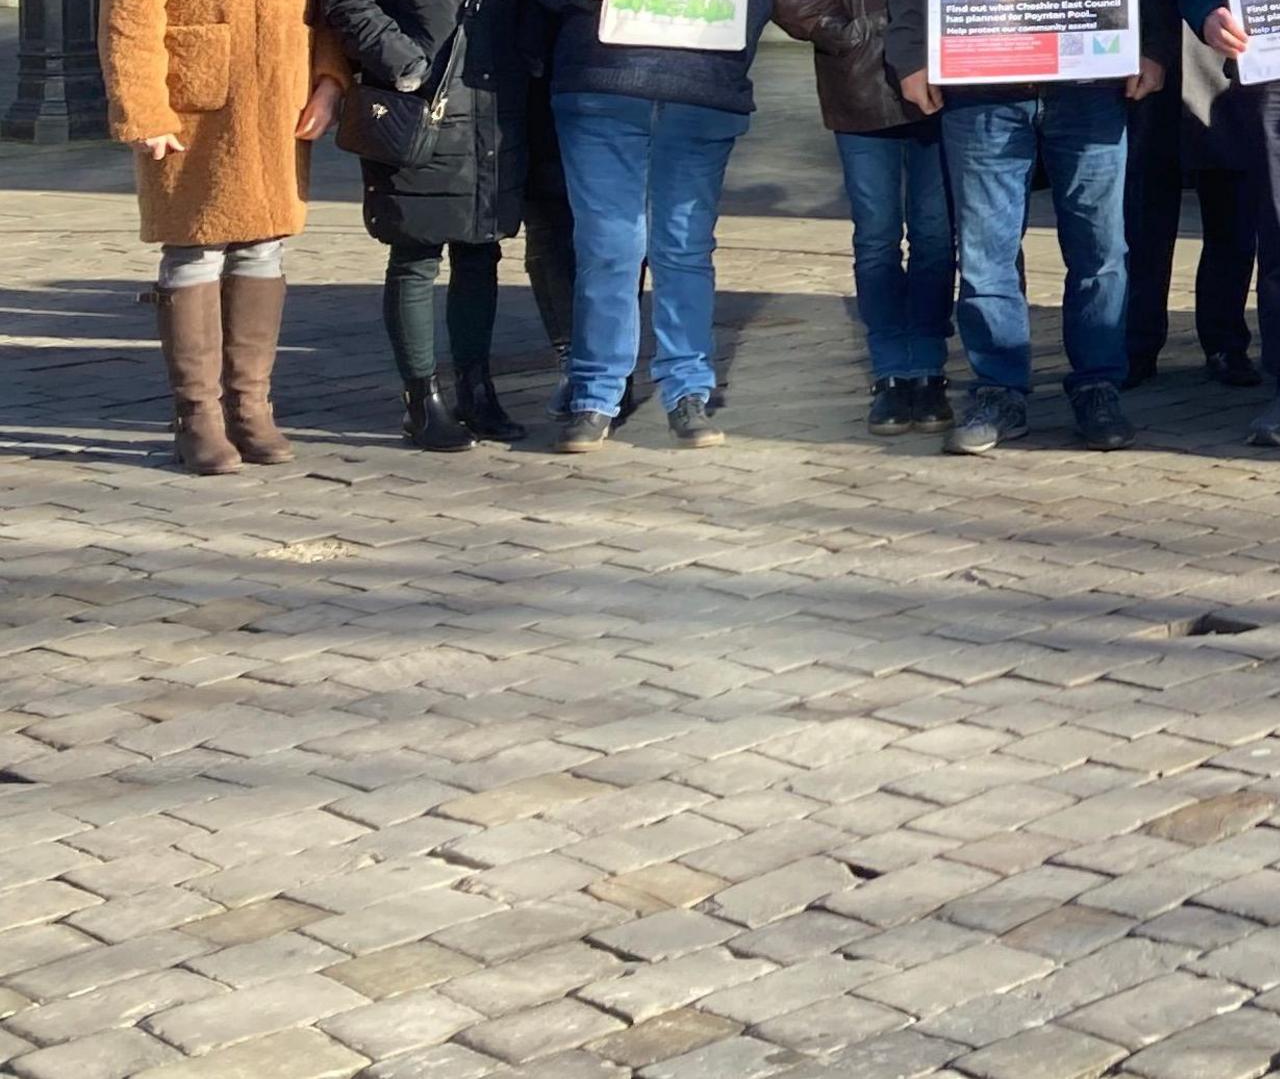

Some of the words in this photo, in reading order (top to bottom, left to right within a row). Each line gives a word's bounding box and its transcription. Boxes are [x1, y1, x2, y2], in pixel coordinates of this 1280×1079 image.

[946, 5, 968, 14] Find
[970, 4, 987, 12] out
[989, 3, 1014, 12] what
[1016, 1, 1059, 11] Cheshire
[1061, 0, 1082, 9] East
[1247, 5, 1268, 14] Find
[946, 14, 964, 23] has
[966, 13, 1006, 24] planned
[1008, 12, 1022, 20] for
[1025, 10, 1066, 22] Poynton
[1248, 14, 1265, 23] has
